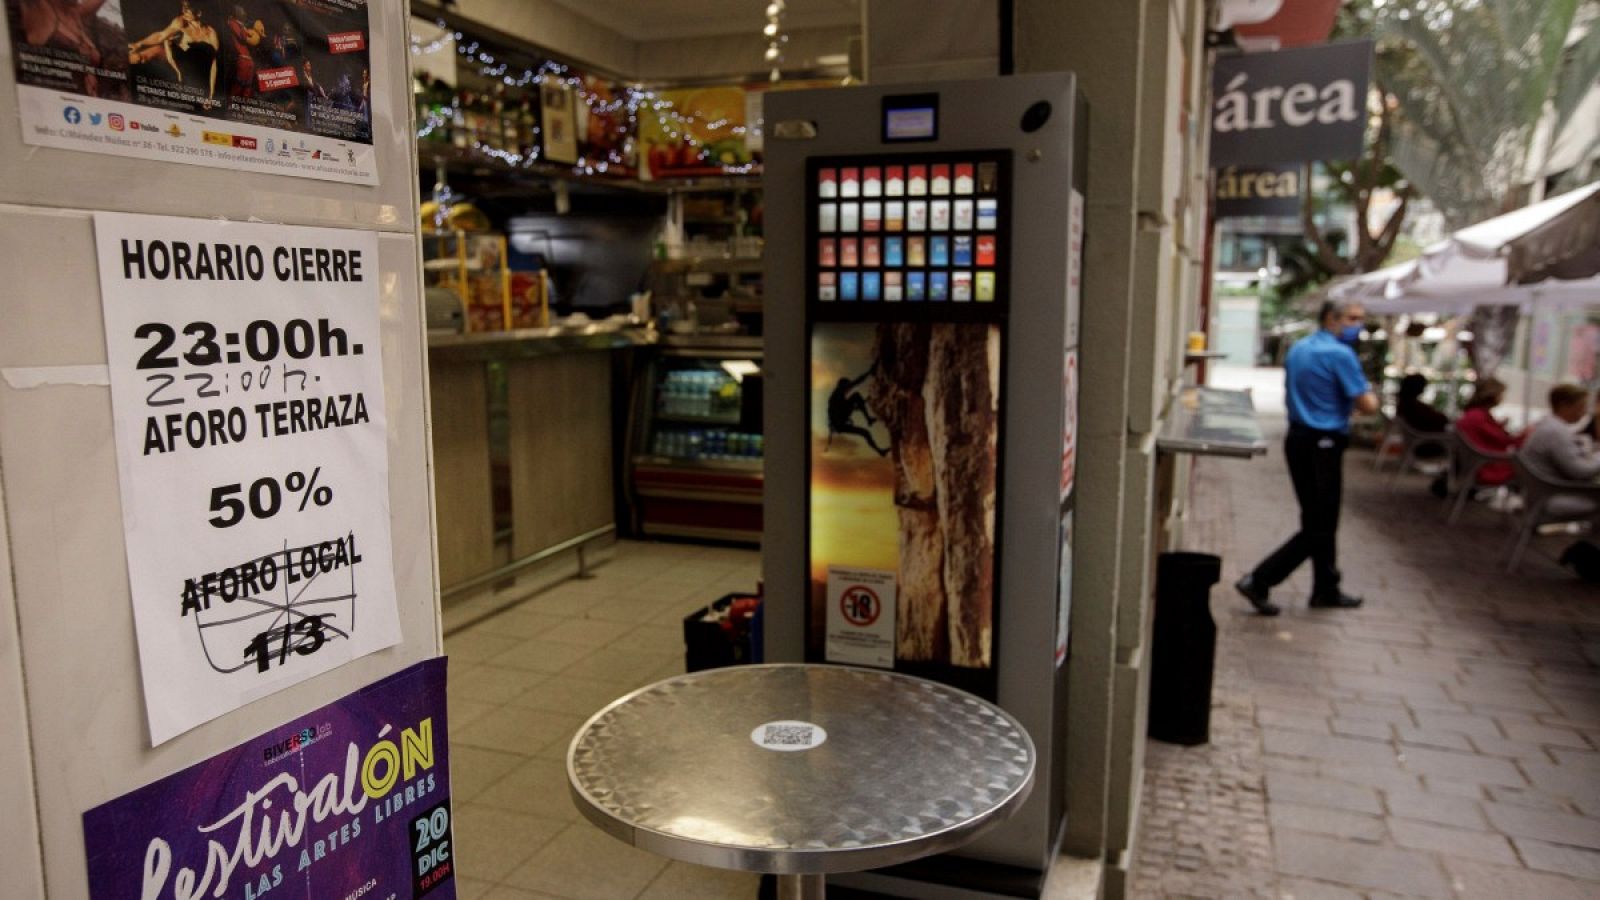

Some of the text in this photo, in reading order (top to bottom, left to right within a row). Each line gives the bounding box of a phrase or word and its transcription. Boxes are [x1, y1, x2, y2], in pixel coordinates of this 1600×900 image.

[1214, 71, 1358, 133] área
[120, 238, 363, 282] HORARIO CIERRE
[134, 318, 364, 370] 23:00h.
[143, 392, 370, 456] AFORO TERRAZA
[208, 466, 333, 529] 50%
[181, 533, 362, 617] AFORO LOCAL
[243, 614, 326, 674] 1/3
[244, 772, 436, 900] LAS ARTES LIBRES
[415, 806, 449, 853] 20
[418, 840, 449, 877] DIC
[420, 863, 450, 891] 19.00H
